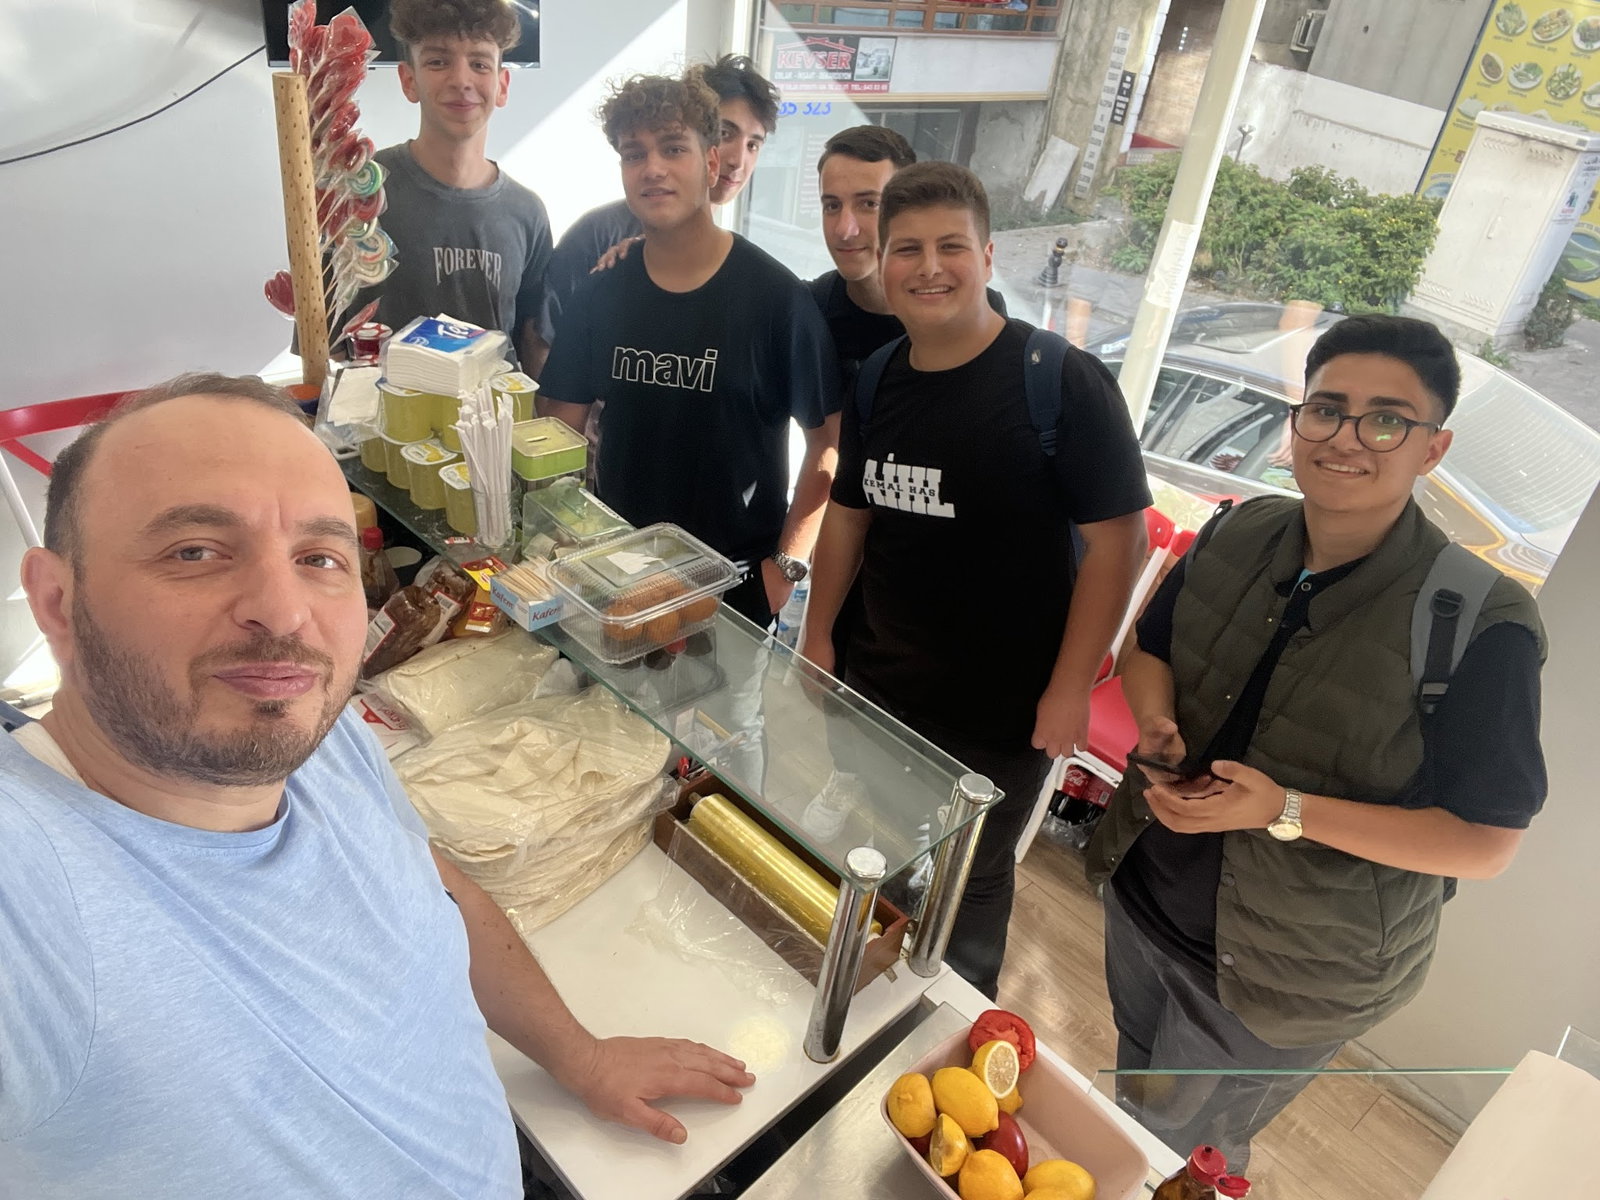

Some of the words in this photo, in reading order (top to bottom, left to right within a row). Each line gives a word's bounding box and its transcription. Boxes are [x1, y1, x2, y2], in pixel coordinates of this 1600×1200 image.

[777, 51, 852, 70] KEVSER
[433, 247, 502, 292] FOREVER
[612, 346, 718, 392] mavi
[863, 478, 904, 492] KEMAL
[909, 487, 936, 497] HAS
